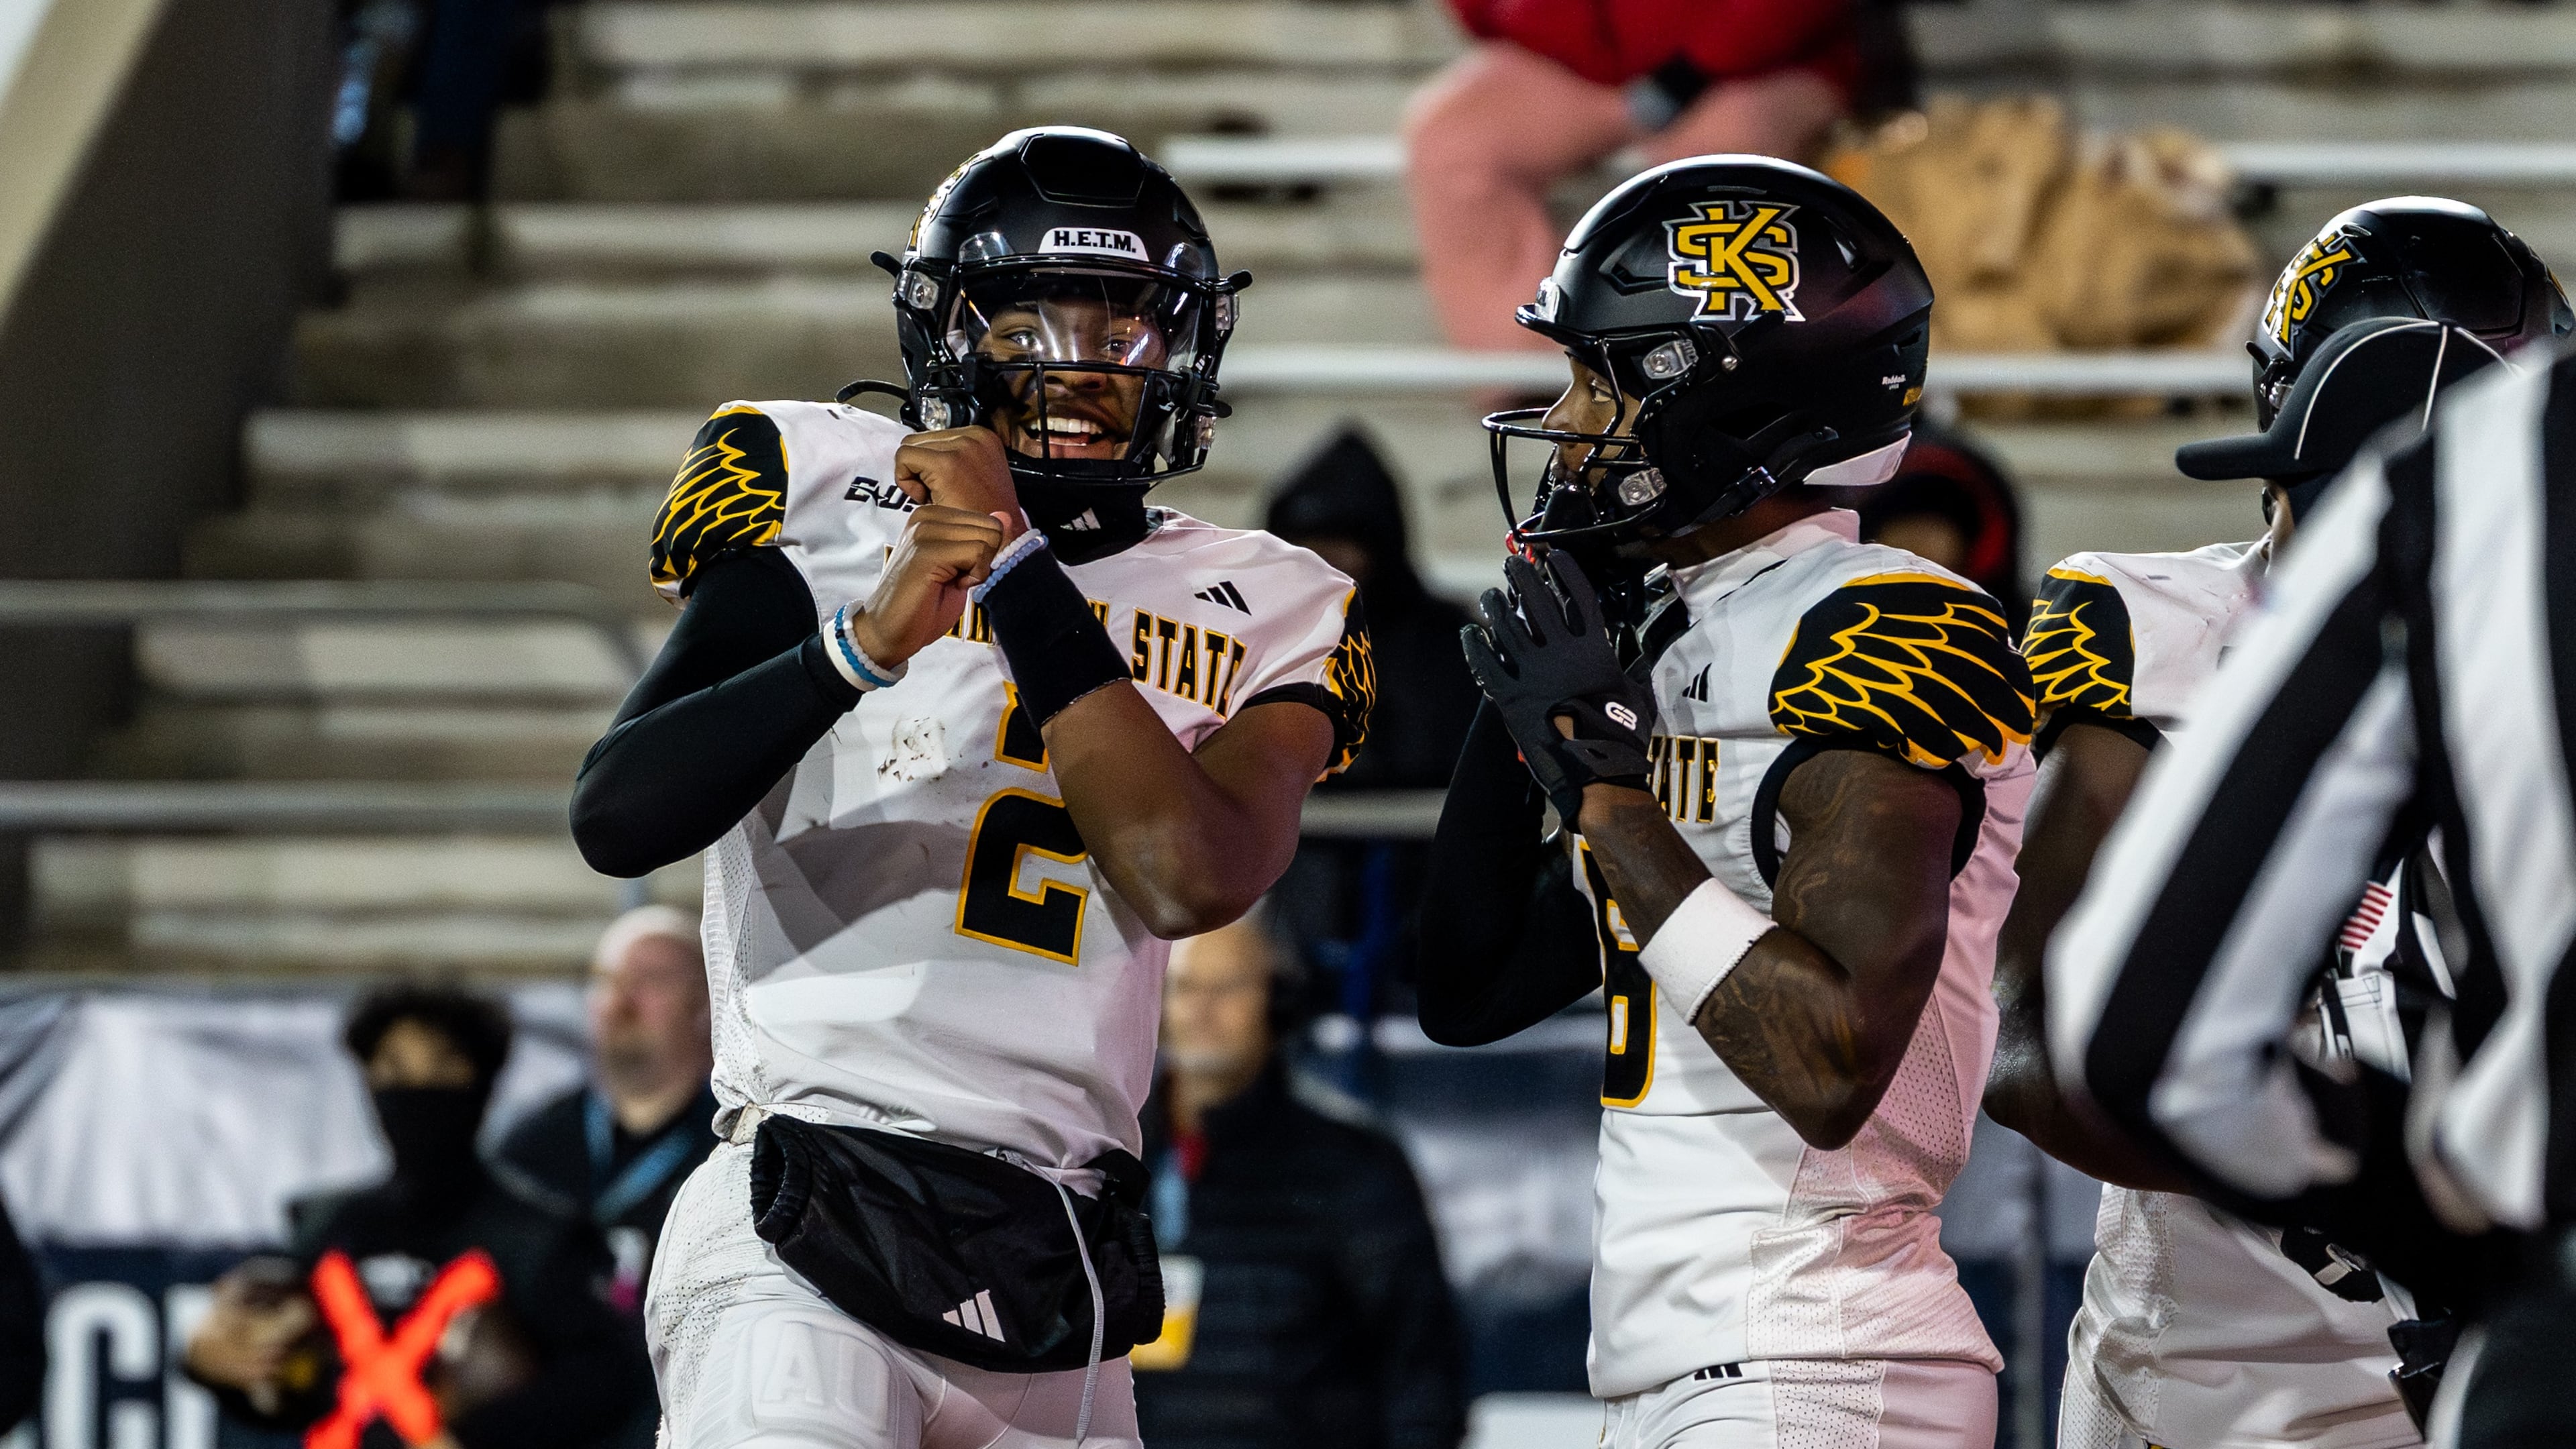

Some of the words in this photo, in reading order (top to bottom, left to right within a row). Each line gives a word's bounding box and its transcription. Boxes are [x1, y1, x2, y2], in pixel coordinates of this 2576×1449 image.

[1053, 230, 1136, 253] H.E.T.M.
[1131, 606, 1248, 722] STATE
[1646, 735, 1721, 824] TATE
